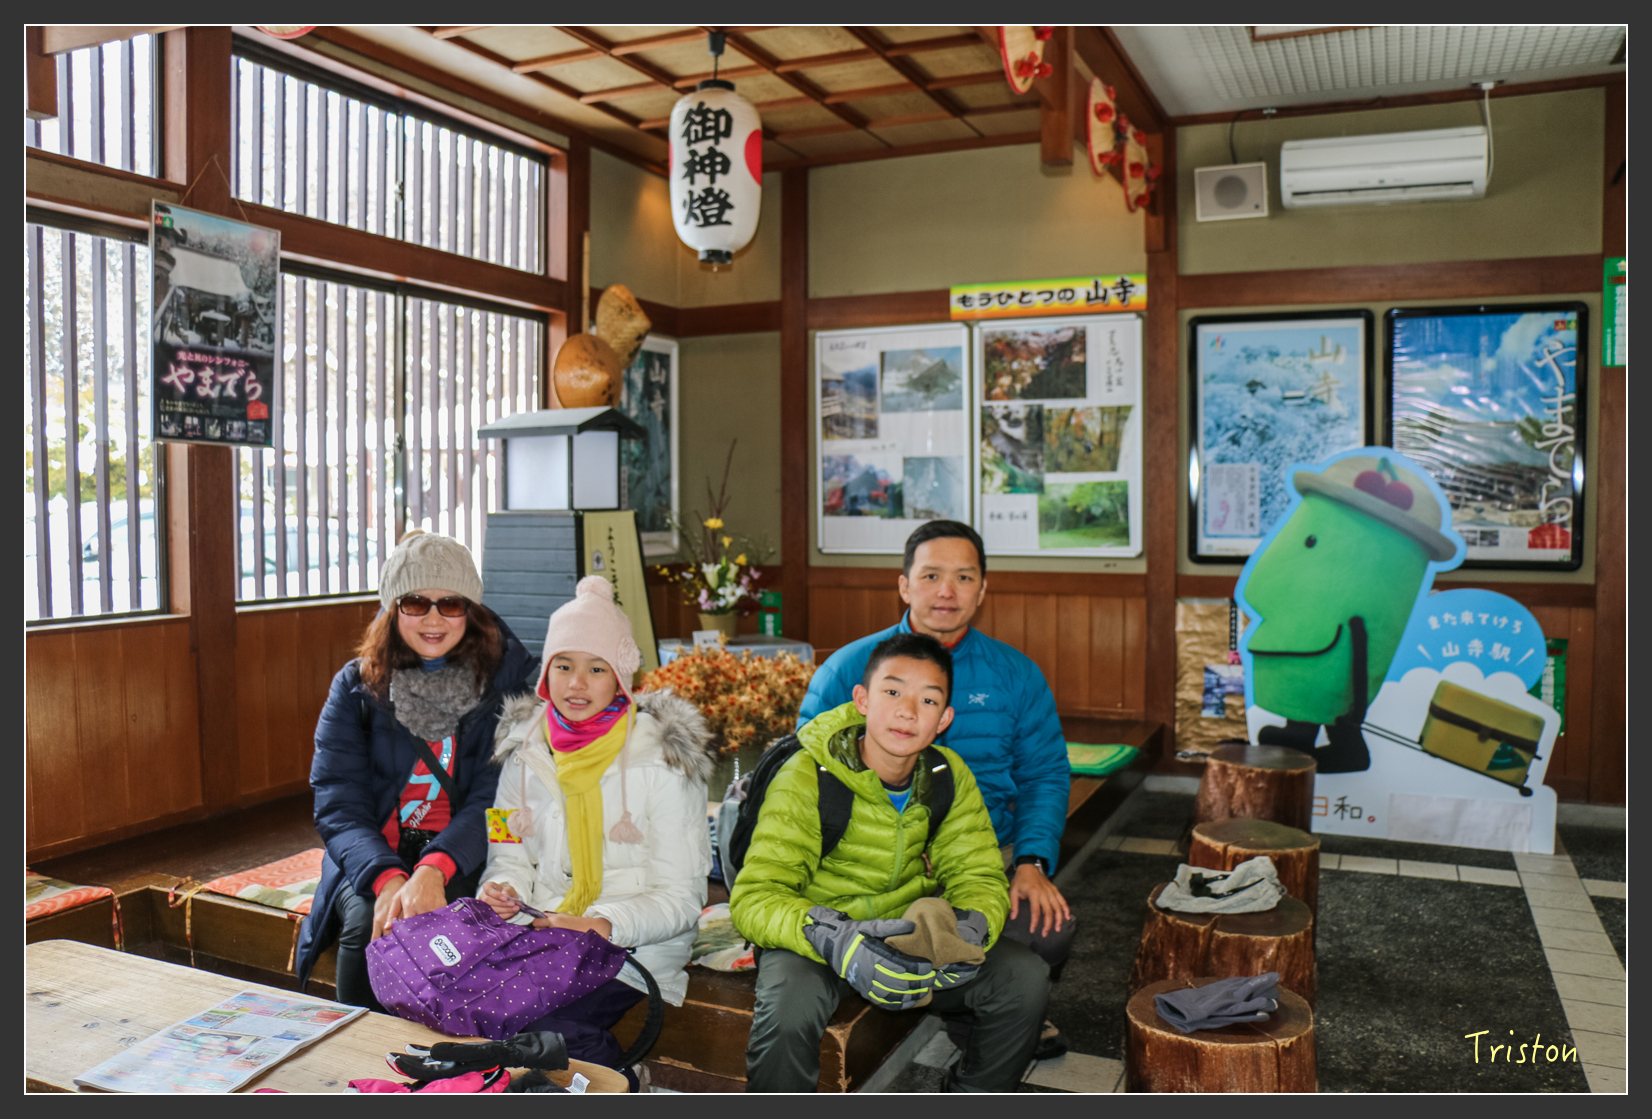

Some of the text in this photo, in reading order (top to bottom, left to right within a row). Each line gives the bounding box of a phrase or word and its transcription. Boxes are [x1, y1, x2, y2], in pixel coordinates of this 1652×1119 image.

[681, 101, 735, 228] 御神燈
[957, 275, 1136, 308] もうひとつの 山寺
[161, 362, 263, 401] やまでら
[650, 359, 667, 421] 山寺
[1309, 335, 1346, 407] 山寺
[1534, 339, 1577, 523] やまでら
[1428, 610, 1523, 634] また来てけろ
[1441, 638, 1511, 662] 山寺駅
